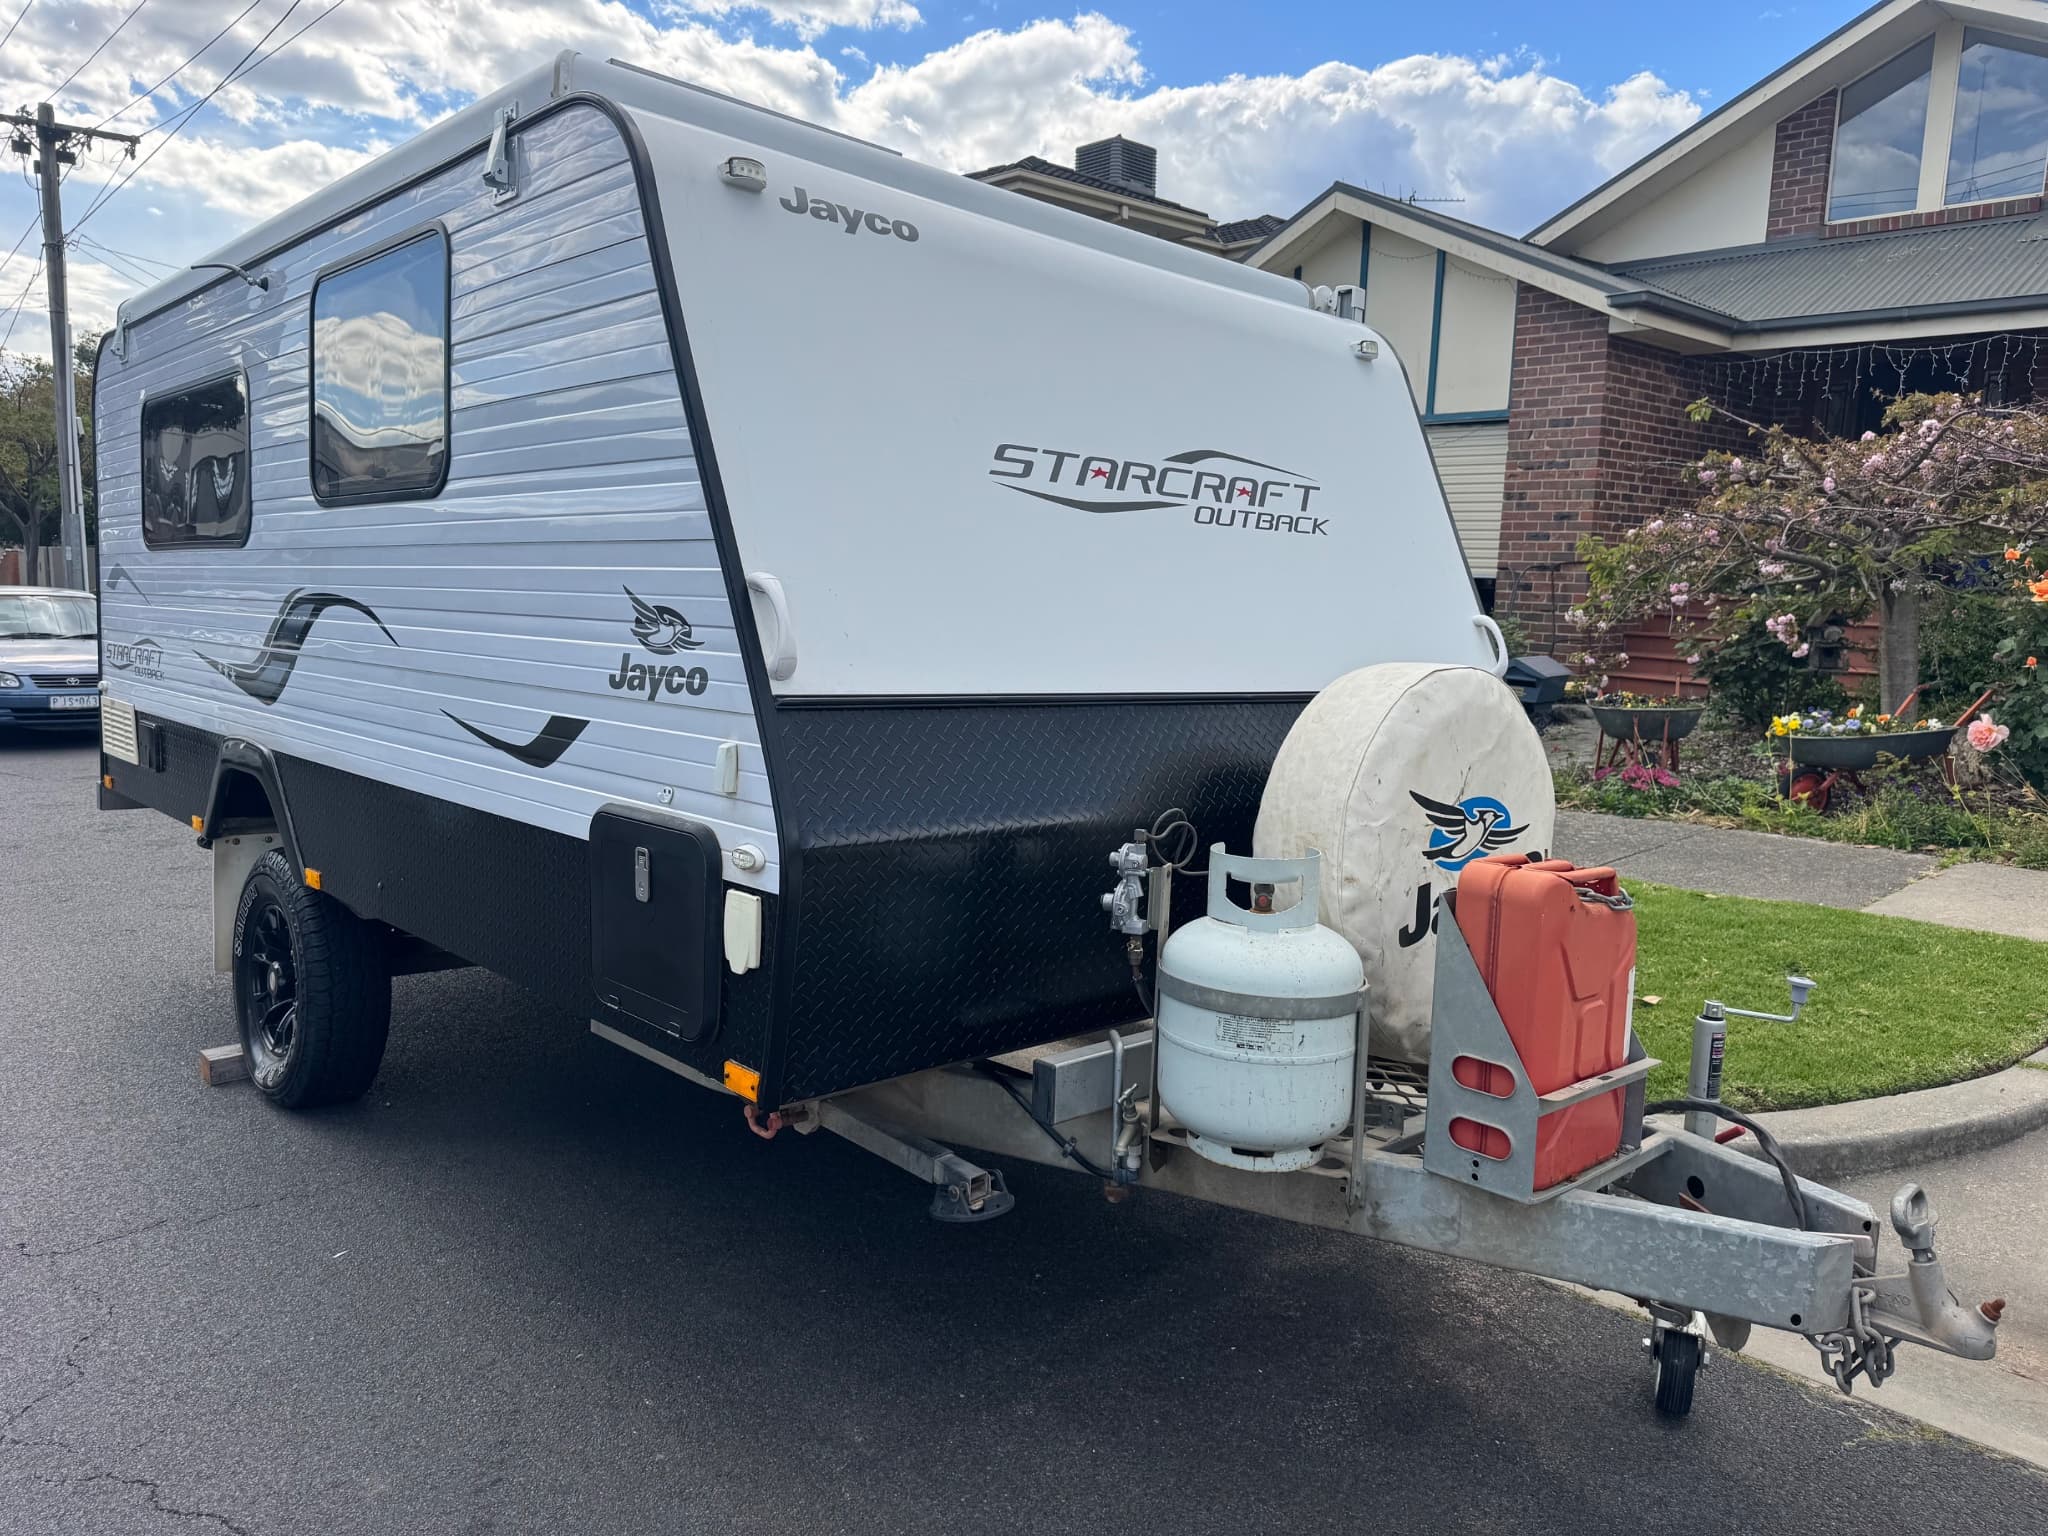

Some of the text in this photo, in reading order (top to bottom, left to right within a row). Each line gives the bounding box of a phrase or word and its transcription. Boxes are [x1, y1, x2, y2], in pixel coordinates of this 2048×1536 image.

[779, 186, 919, 242] Jayco
[990, 443, 1320, 512] STARCRAFT
[1193, 506, 1330, 536] OUTBACK
[106, 643, 164, 668] STARCRAFT
[134, 666, 165, 681] OUTBACK
[608, 653, 708, 702] Jayco
